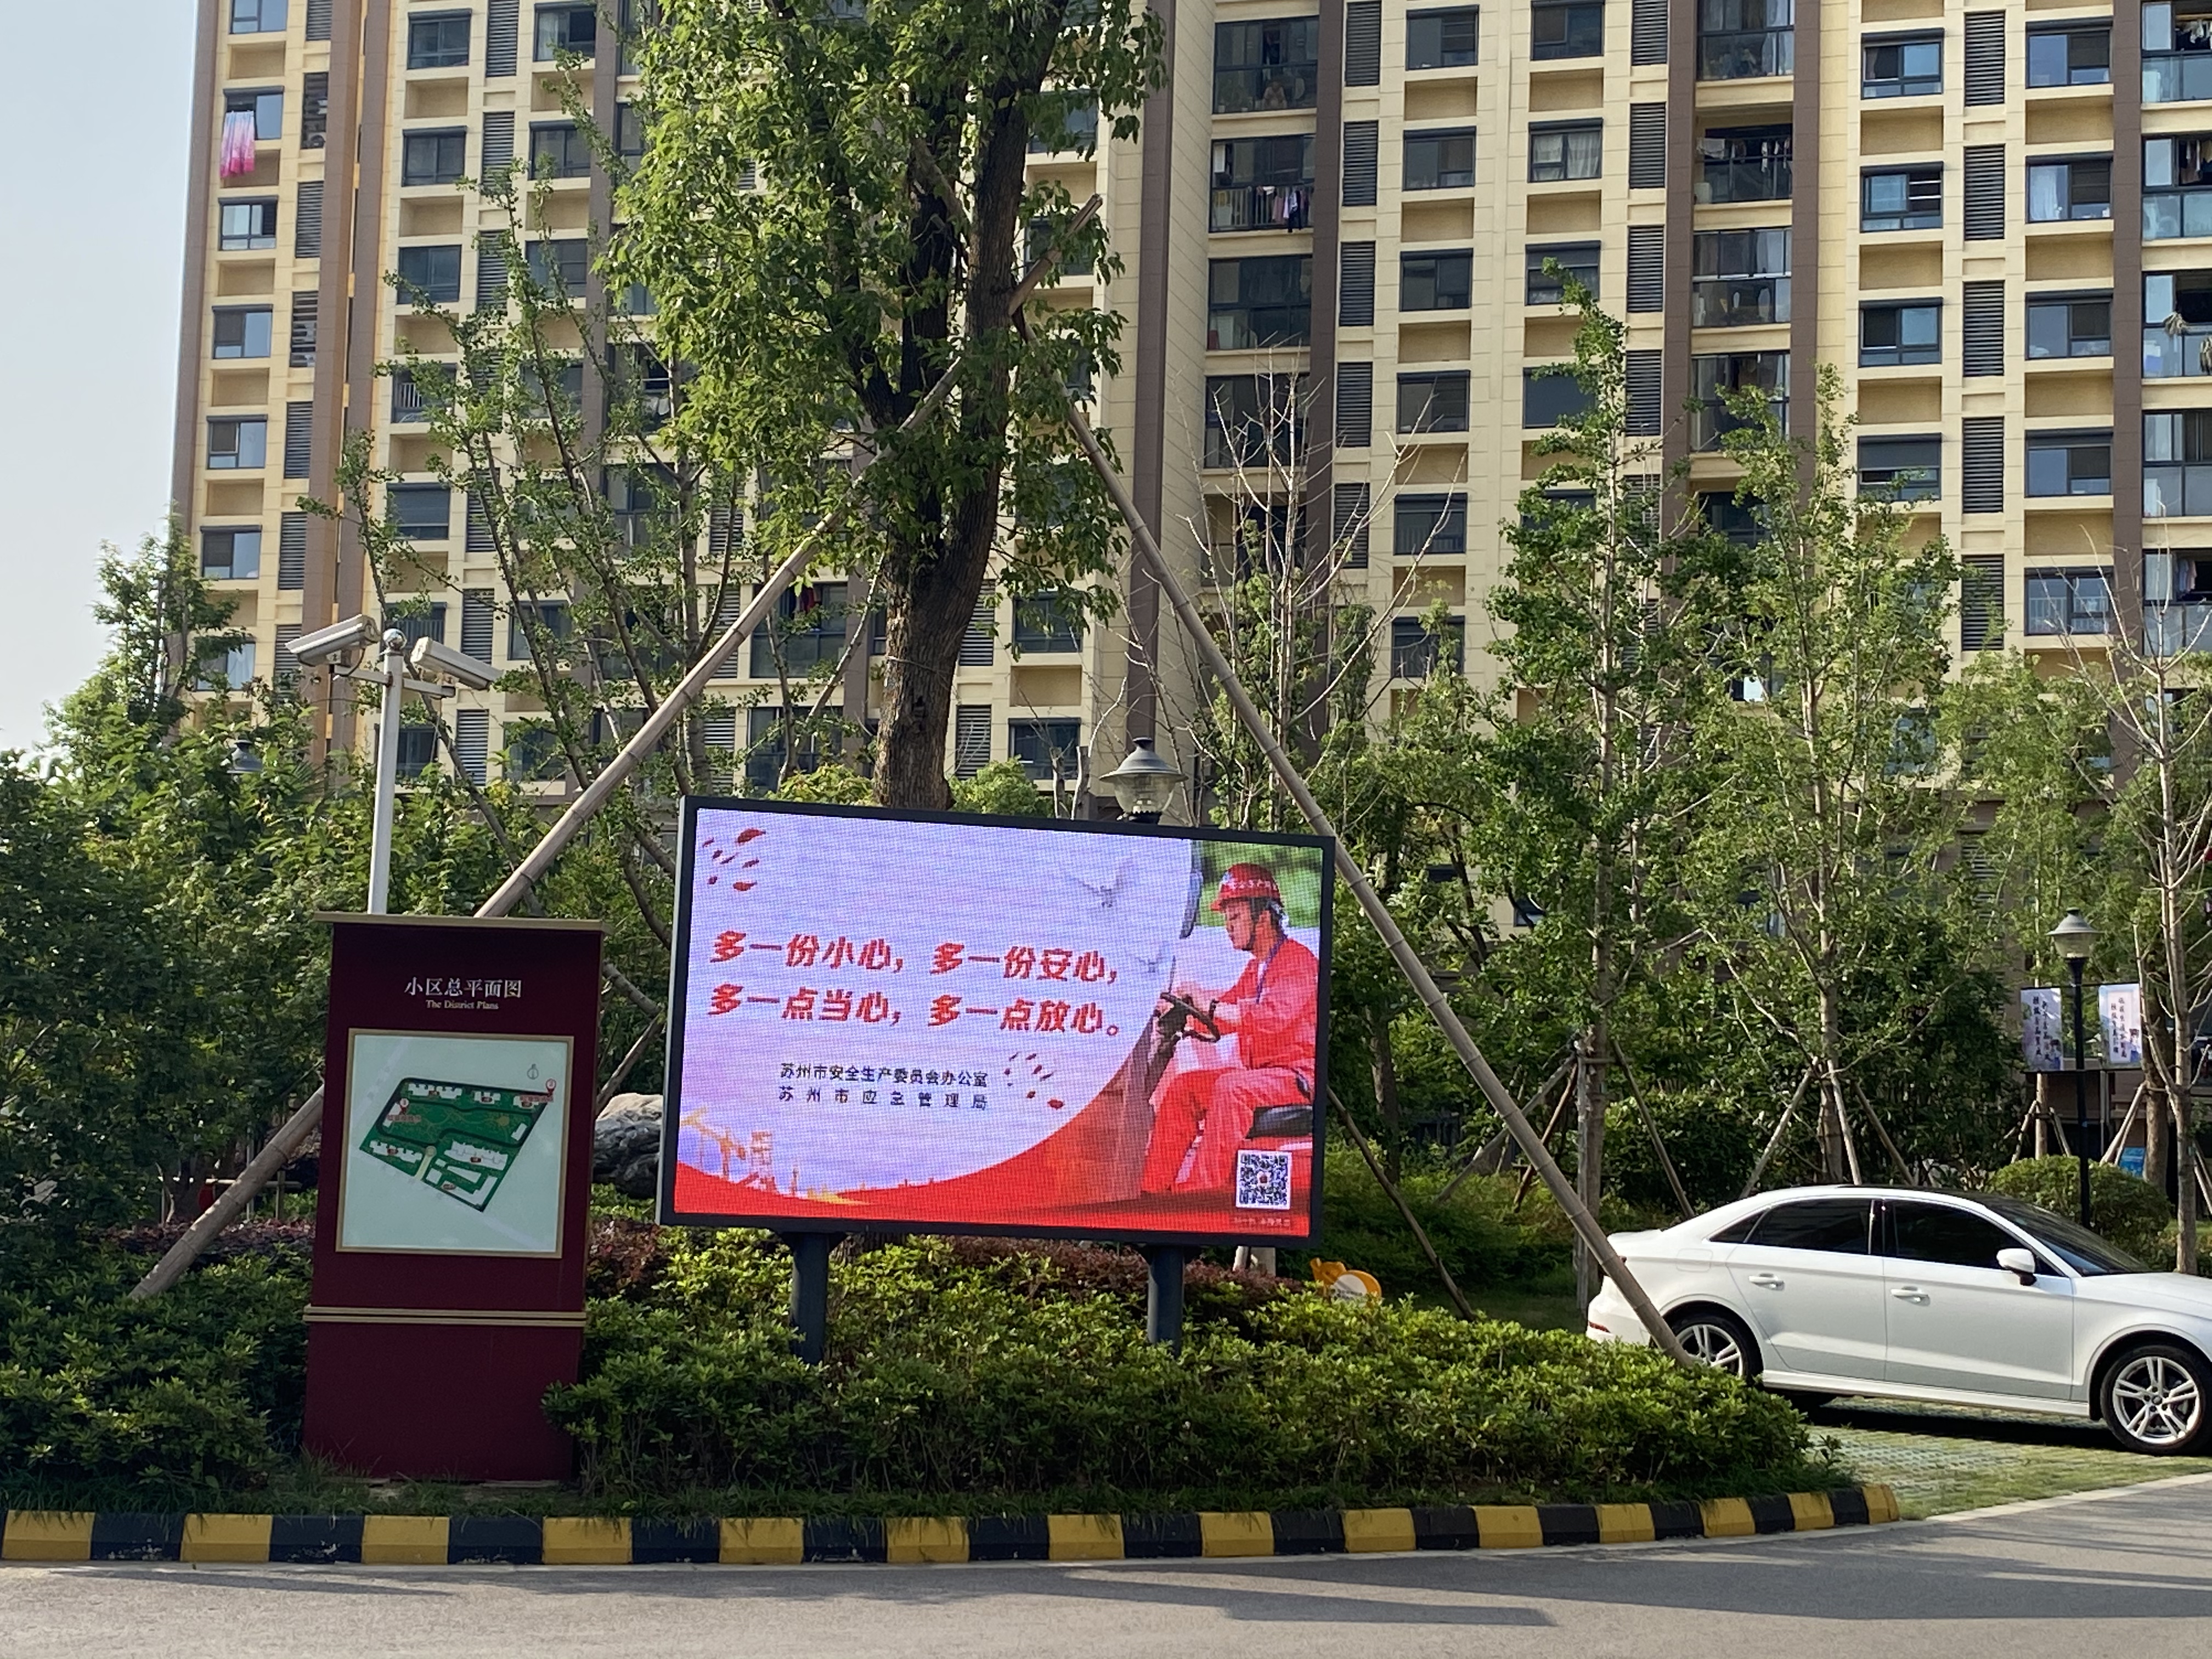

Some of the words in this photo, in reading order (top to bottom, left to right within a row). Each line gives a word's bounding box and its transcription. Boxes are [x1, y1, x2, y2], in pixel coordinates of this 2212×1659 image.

[404, 977, 522, 998] 小区总平面图
[426, 1000, 441, 1008] The
[444, 1000, 474, 1009] District
[476, 1001, 499, 1009] Plans
[780, 1062, 988, 1087] 苏州市安全生产委员会办公室
